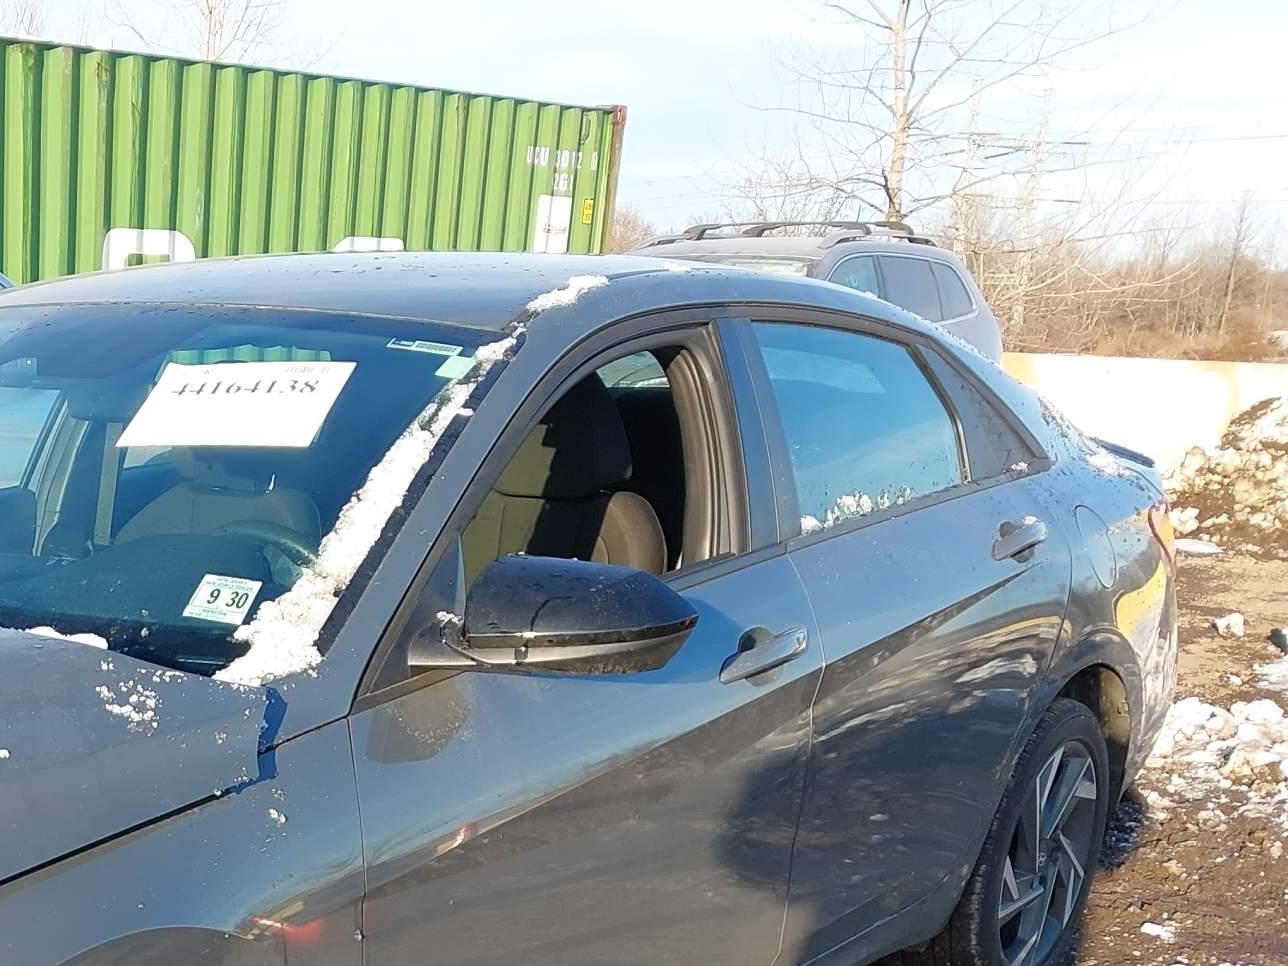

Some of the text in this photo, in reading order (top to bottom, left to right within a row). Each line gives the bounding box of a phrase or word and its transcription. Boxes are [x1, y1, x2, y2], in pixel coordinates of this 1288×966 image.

[171, 379, 320, 396] 44164138
[206, 588, 249, 609] 9 30
